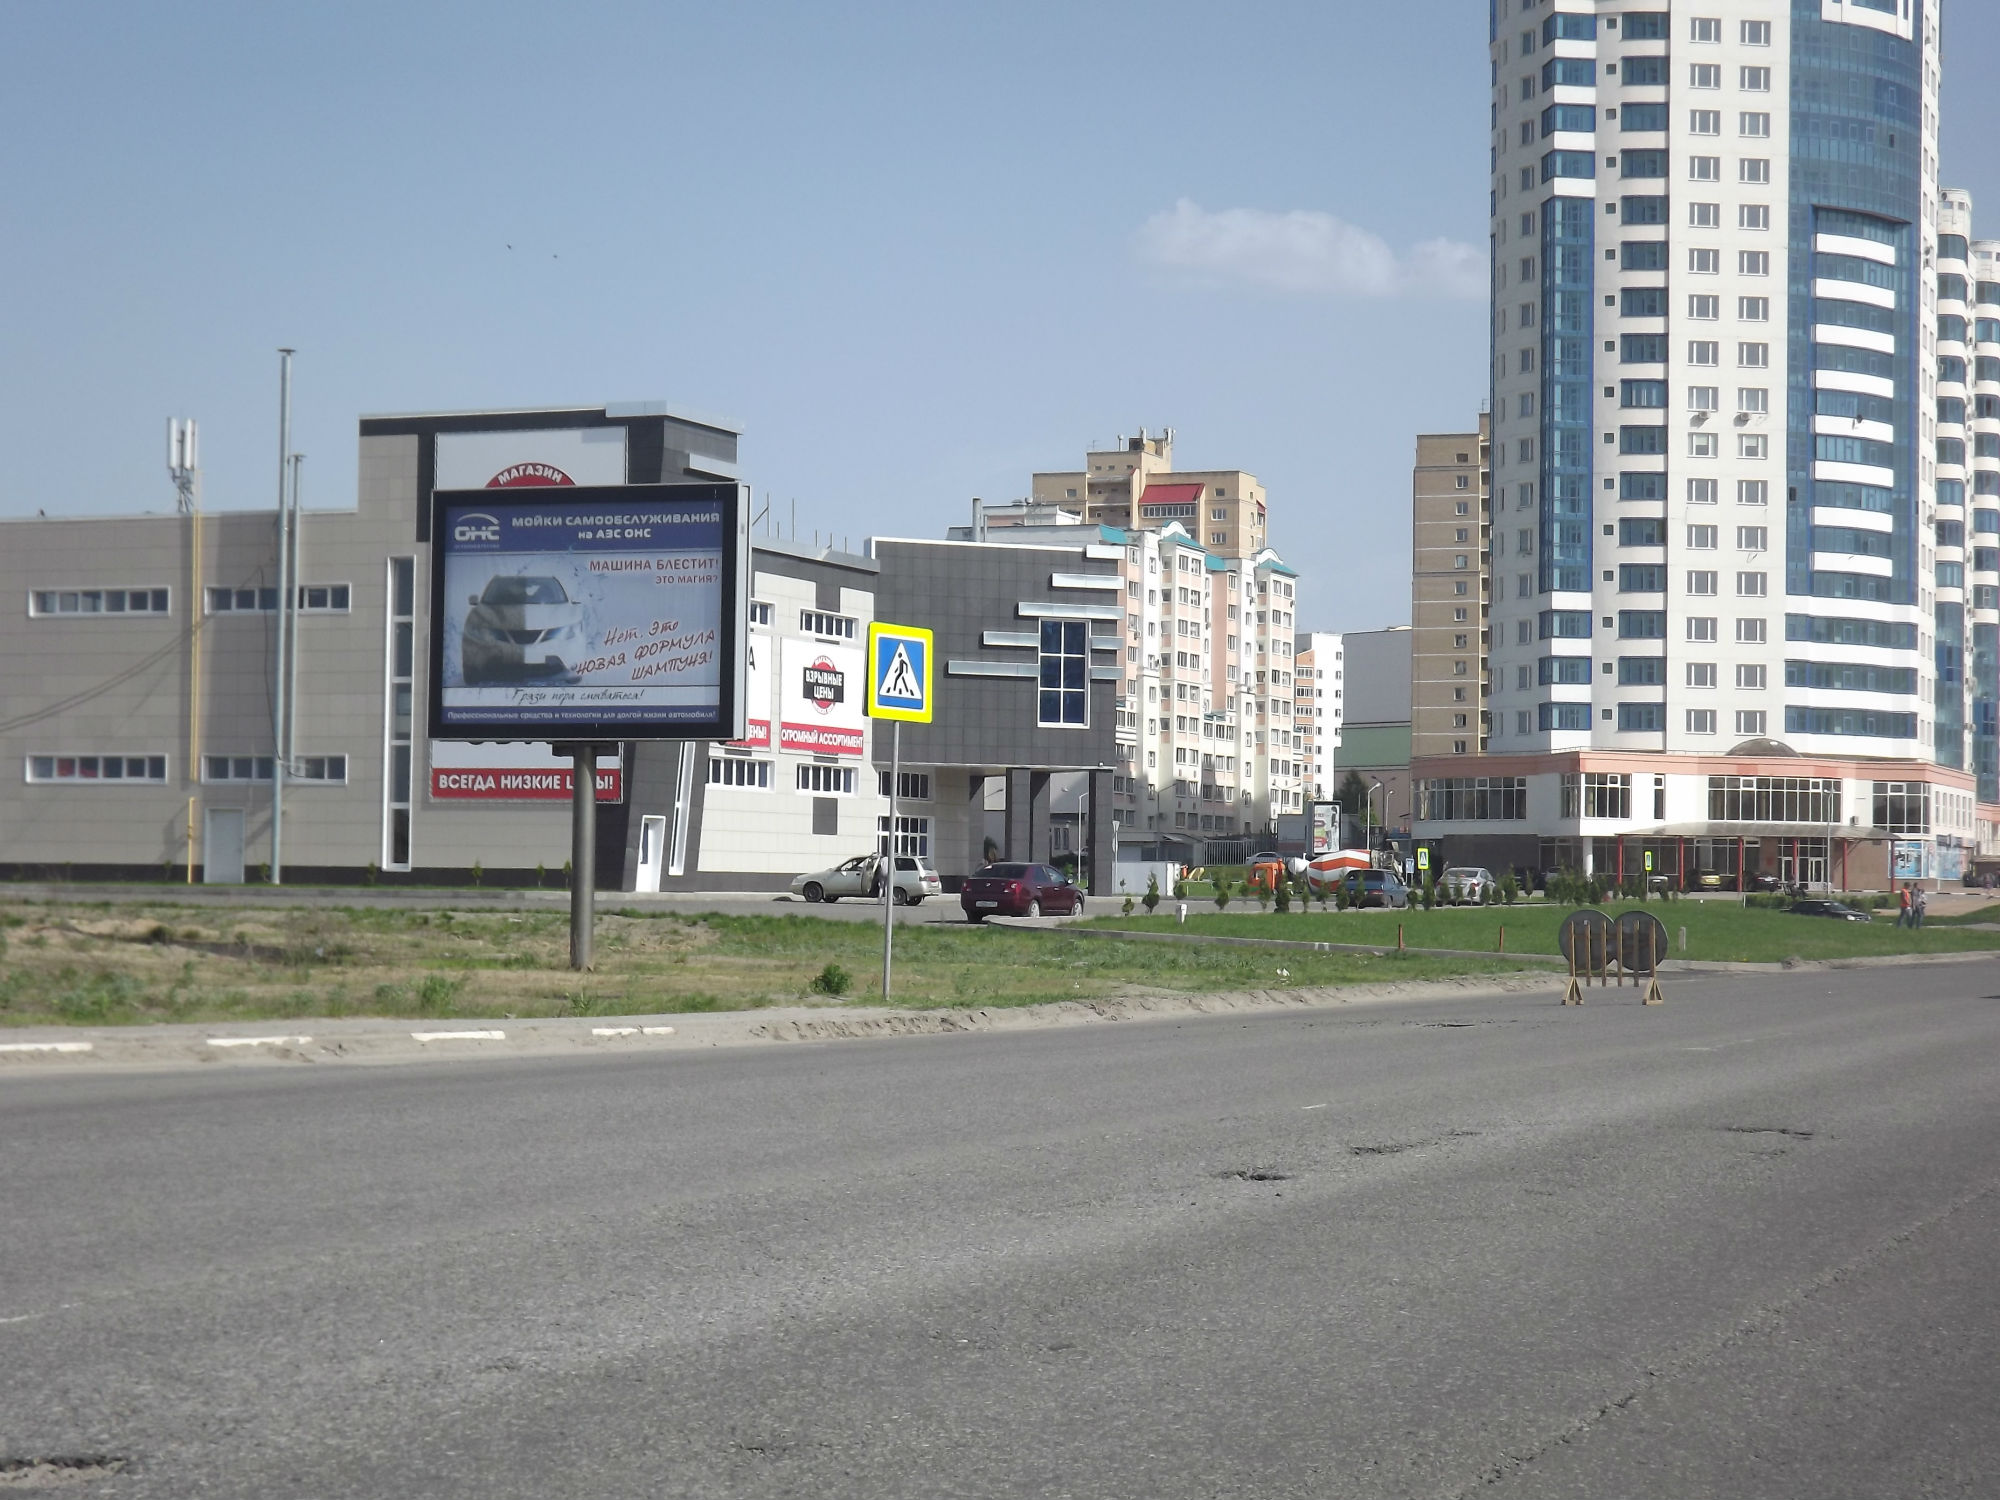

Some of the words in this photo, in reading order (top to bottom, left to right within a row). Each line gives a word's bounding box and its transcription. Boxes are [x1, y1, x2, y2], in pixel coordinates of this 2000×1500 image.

[498, 464, 562, 485] МАГАЗИН
[512, 515, 563, 527] МОЙКИ
[565, 512, 720, 526] САМООБСЛУЖИВАНИЯ
[454, 525, 500, 541] ОНС
[578, 531, 593, 539] на
[596, 529, 622, 539] АЗС
[624, 528, 651, 538] ОНС
[589, 559, 652, 571] МАШИНА
[656, 558, 719, 570] БЛЕСТИТ!
[656, 575, 675, 584] ЭТО
[677, 574, 718, 584] МАГИЯ?
[604, 627, 643, 646] Нет.
[648, 620, 679, 636] Это
[576, 652, 626, 675] НОВАЯ
[634, 629, 715, 660] ФОРМУЛА
[631, 650, 713, 681] ШАМПУНЯ!
[805, 669, 843, 686] ВЗРЫВНЫЕ
[813, 685, 834, 700] ЦЕНЫ
[781, 729, 819, 743] ОГРОМНЫЙ
[819, 732, 863, 748] АССОРТИМЕНТ
[438, 774, 496, 791] ВСЕГДА
[501, 775, 560, 790] НИЗКИЕ
